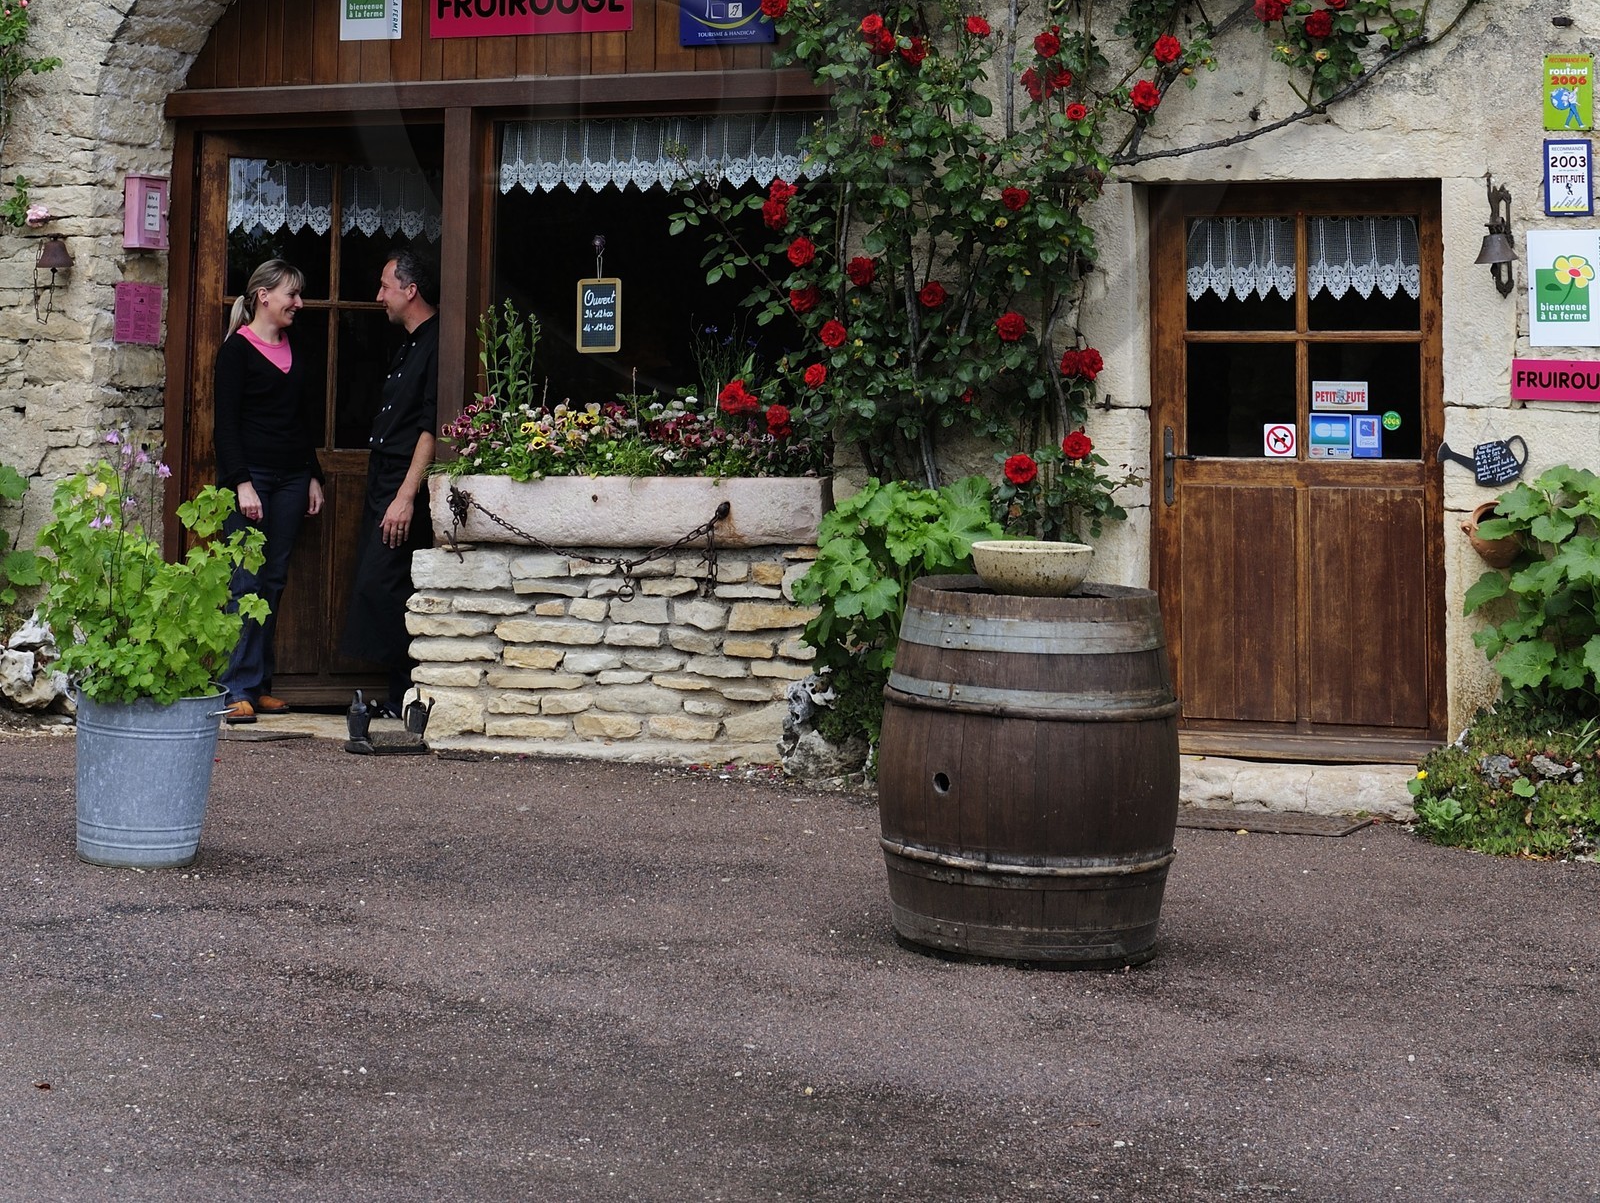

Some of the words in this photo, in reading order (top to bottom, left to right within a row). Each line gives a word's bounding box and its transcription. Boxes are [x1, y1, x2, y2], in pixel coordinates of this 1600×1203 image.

[349, 3, 384, 11] bienvenue
[363, 10, 384, 18] ferme
[698, 30, 723, 38] TOURISME
[728, 29, 756, 37] HANDICAP
[1549, 66, 1588, 76] routard
[1550, 76, 1588, 86] 2006
[1550, 155, 1587, 168] 2003
[1552, 174, 1569, 184] PETIT
[1570, 172, 1586, 184] FUTÉ
[583, 289, 616, 307] Ouvert
[1540, 302, 1587, 311] bienvenue
[1540, 311, 1546, 320] à
[1549, 311, 1558, 320] la
[1560, 311, 1588, 320] ferme
[1315, 391, 1337, 402] PETIT
[1346, 388, 1366, 403] FUTÉ
